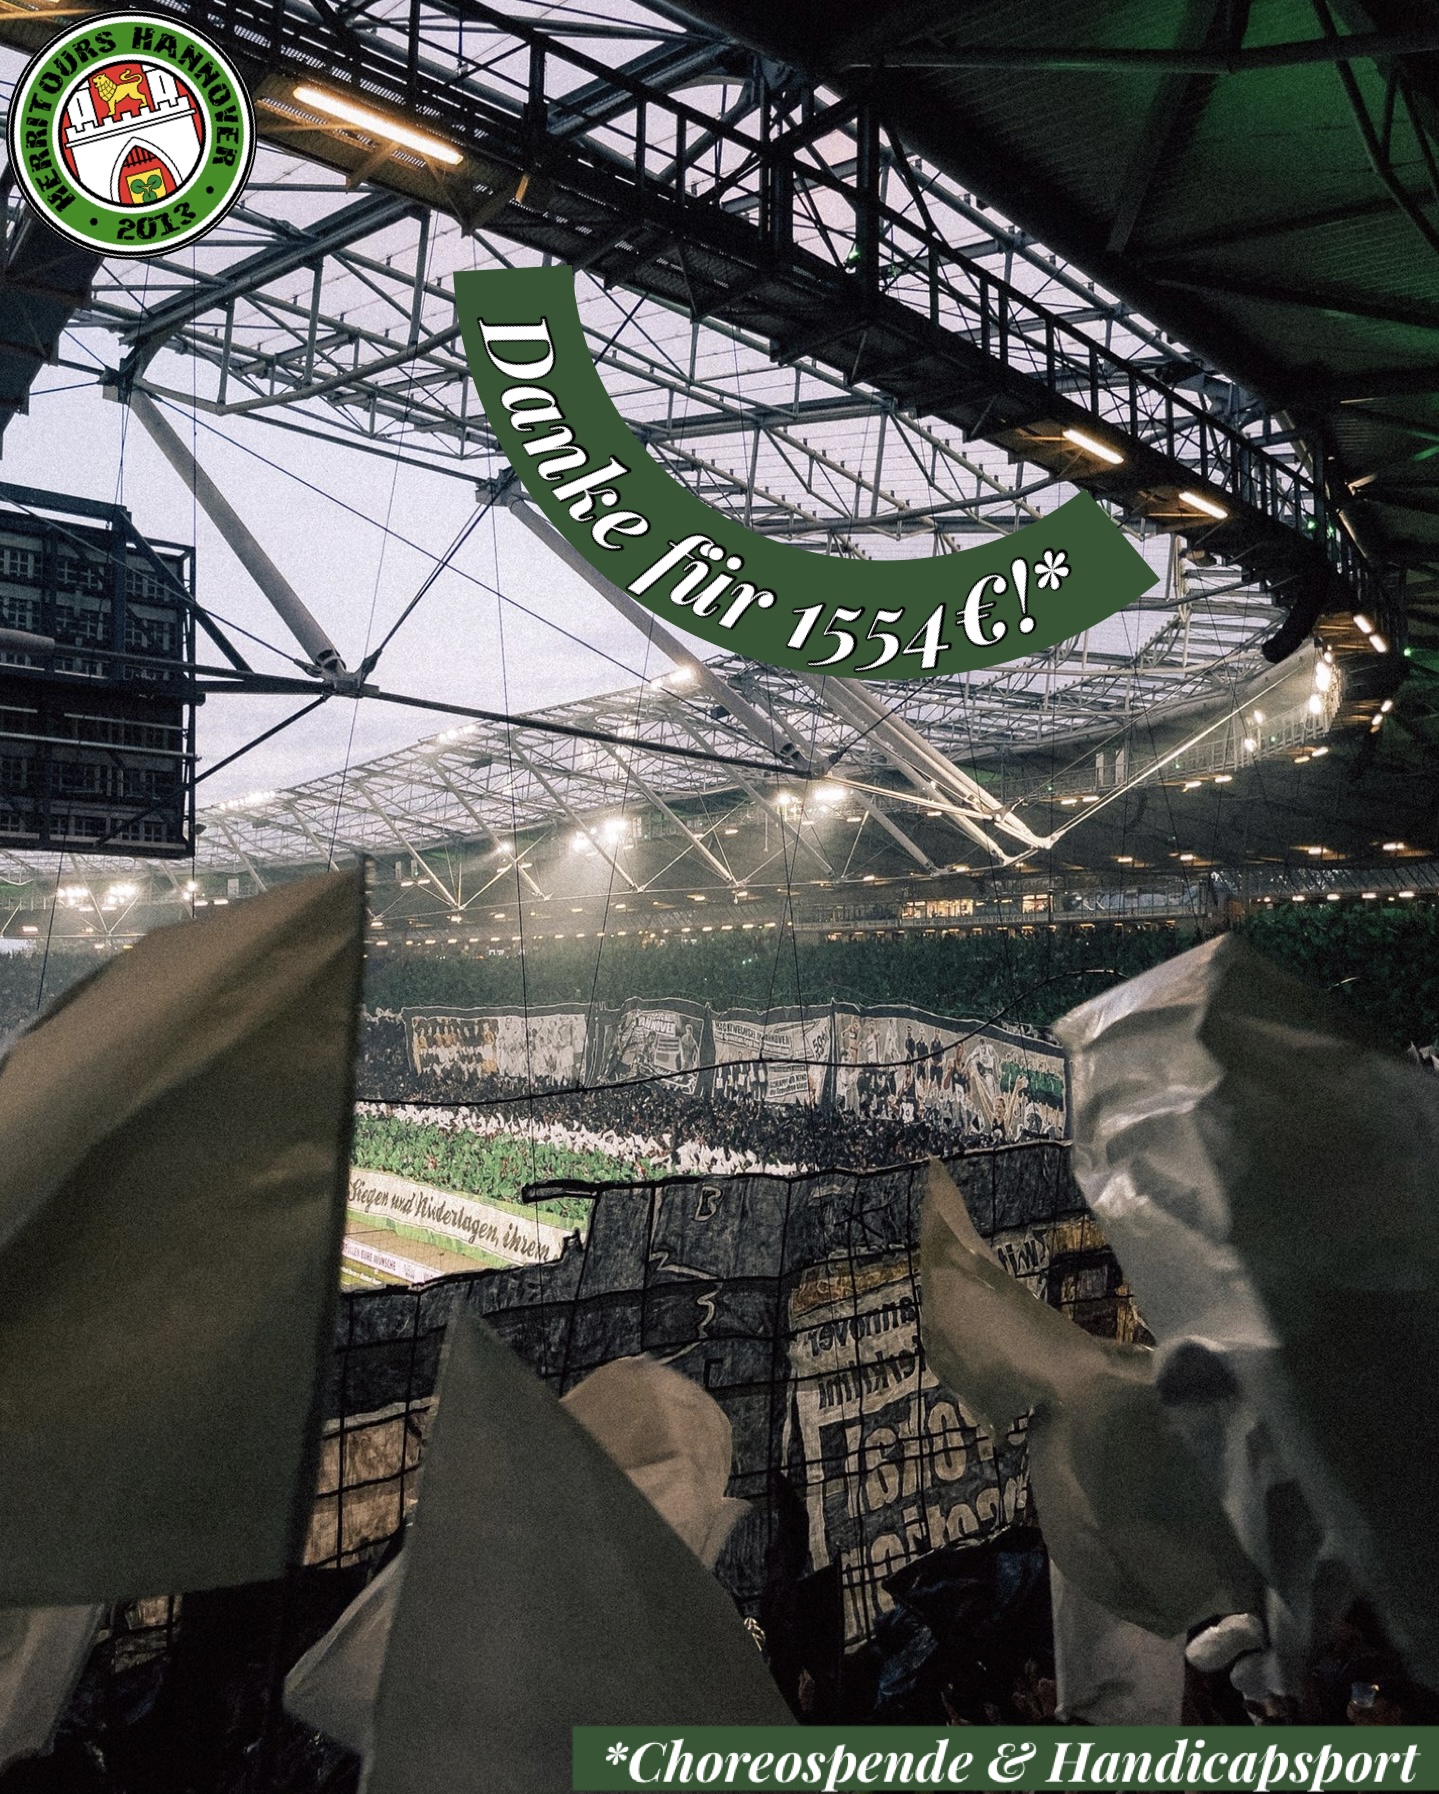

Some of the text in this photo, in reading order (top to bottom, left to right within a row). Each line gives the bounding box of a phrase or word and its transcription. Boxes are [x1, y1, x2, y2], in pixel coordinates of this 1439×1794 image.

[348, 1178, 389, 1211] Siegen
[391, 1192, 416, 1215] und
[502, 1222, 550, 1260] ihrem
